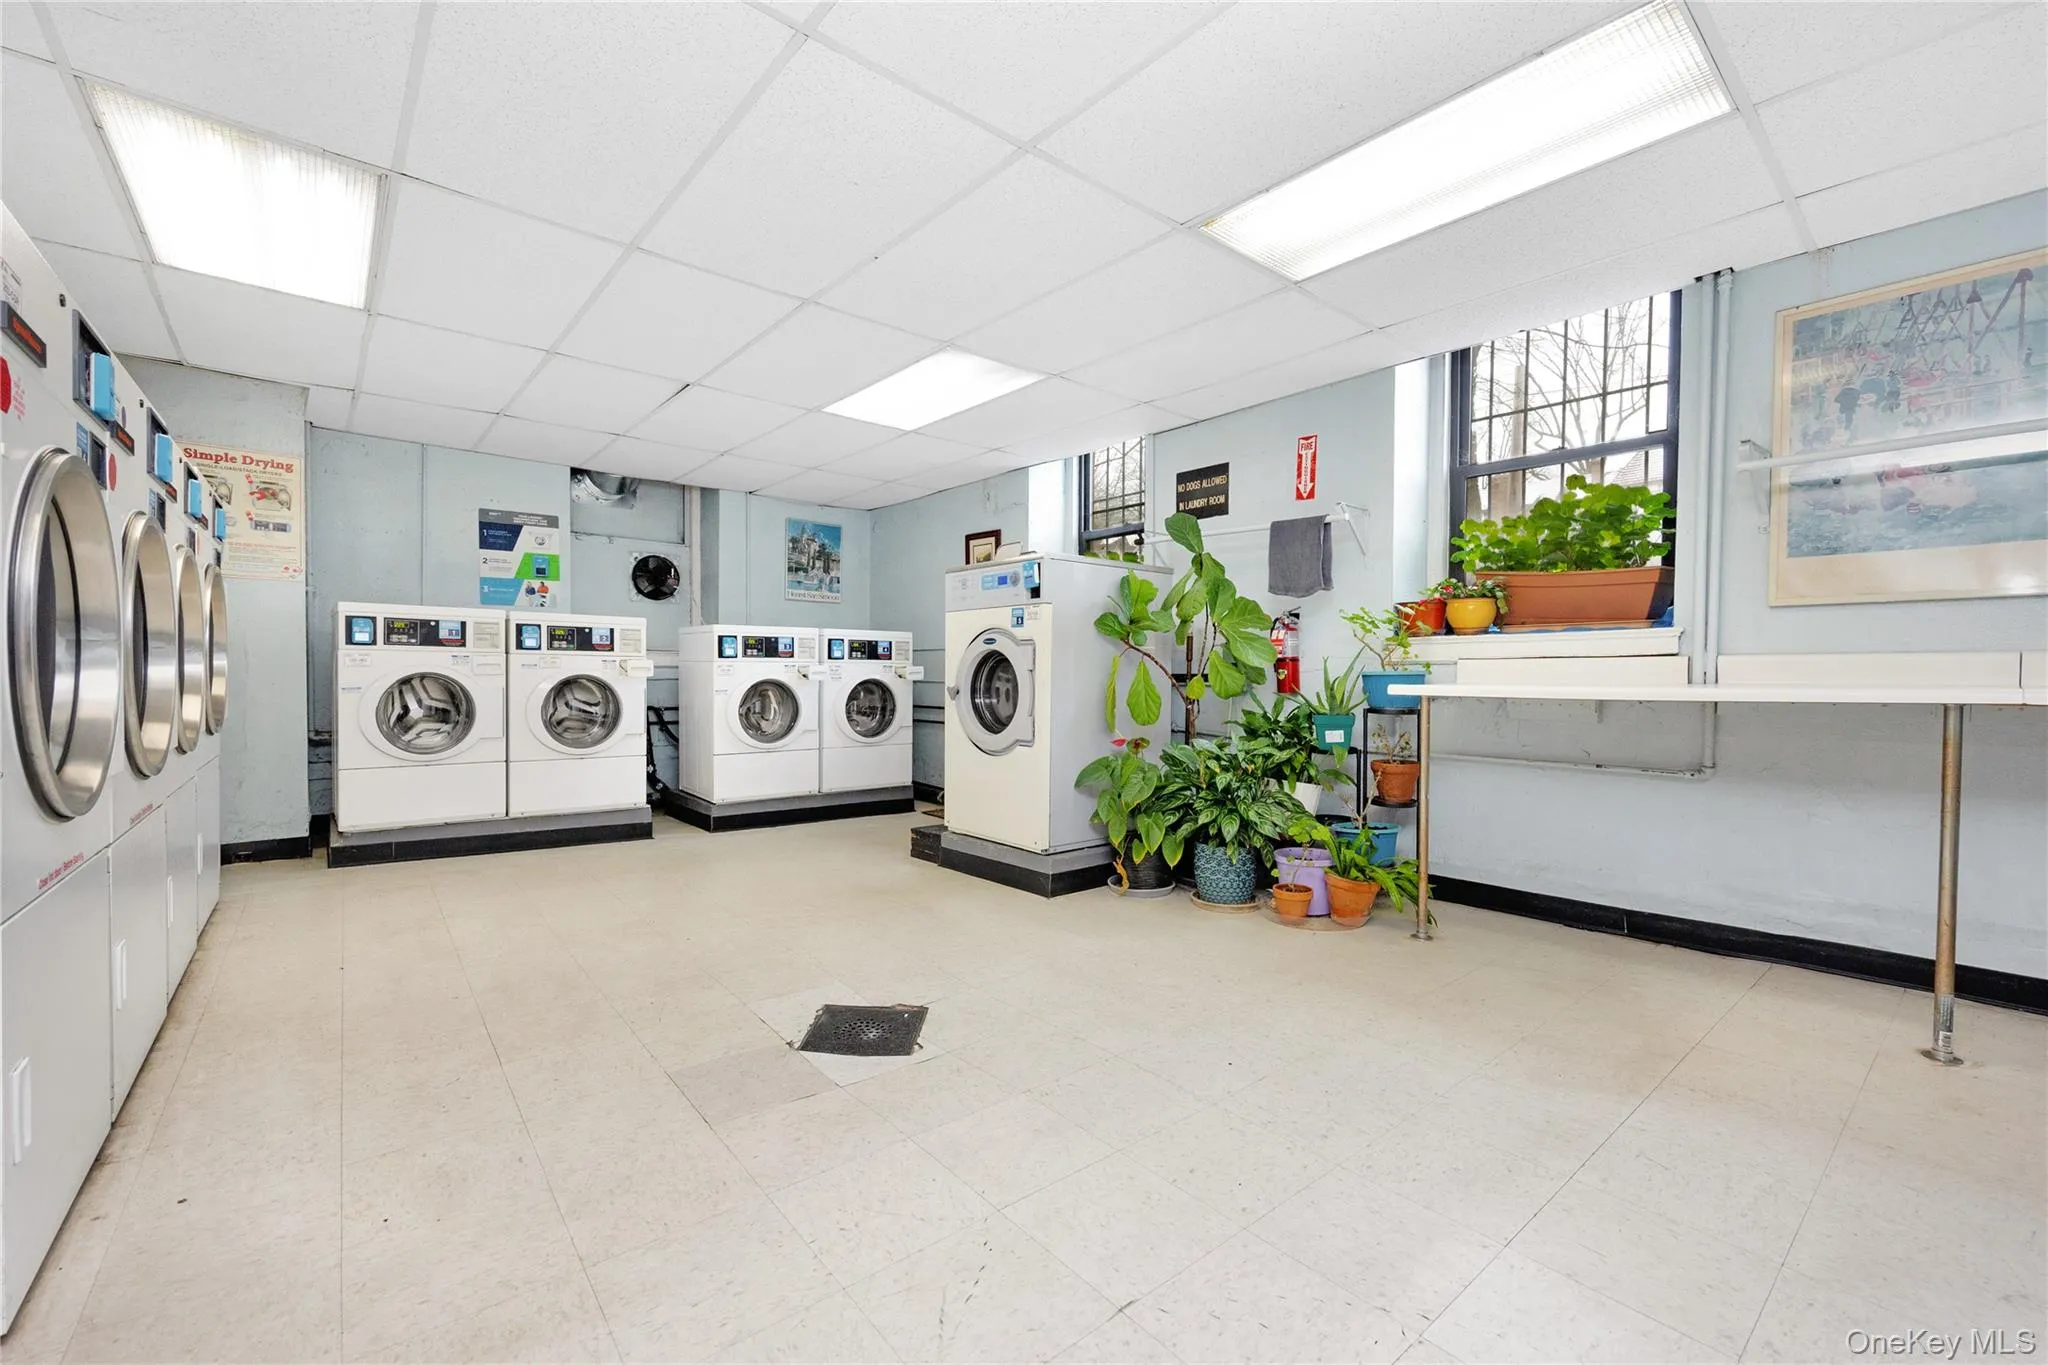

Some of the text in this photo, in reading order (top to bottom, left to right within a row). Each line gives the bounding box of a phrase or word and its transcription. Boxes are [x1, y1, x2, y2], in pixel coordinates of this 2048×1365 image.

[1301, 441, 1313, 452] FIRE
[183, 448, 294, 473] Simple Drying
[1178, 475, 1227, 493] NO DOGS ALLOWED
[1179, 494, 1225, 511] IN LAUNDRY ROOM
